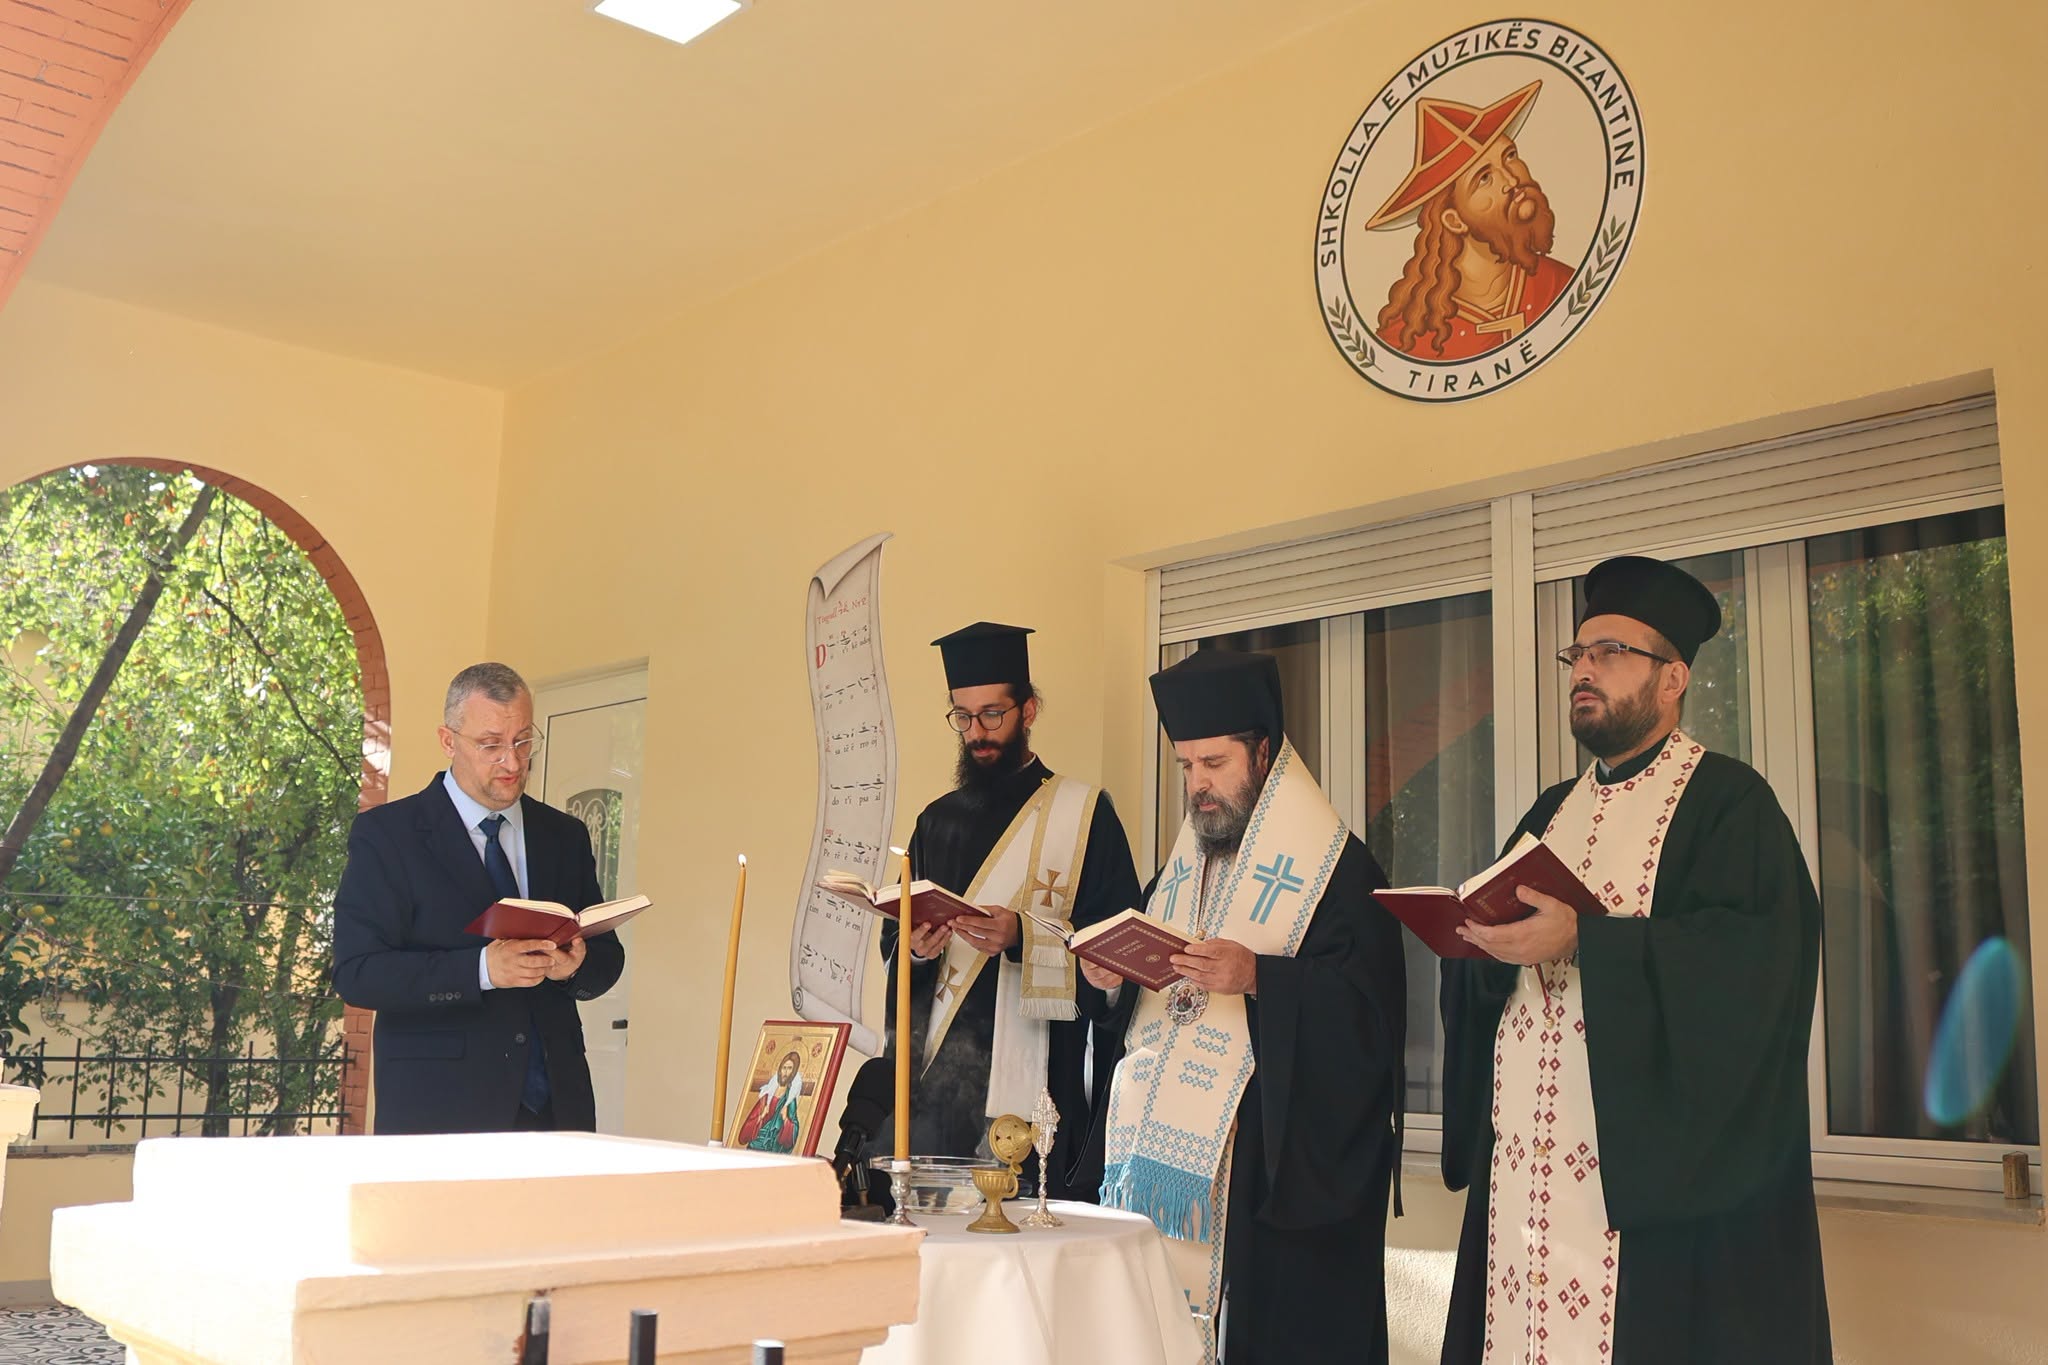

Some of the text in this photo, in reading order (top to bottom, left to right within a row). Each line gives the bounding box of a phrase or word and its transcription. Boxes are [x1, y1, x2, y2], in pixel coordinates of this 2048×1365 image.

[1320, 22, 1636, 268] SHKOLLA E MUZIKËS BIZANTINE
[1408, 339, 1537, 393] TIRANË
